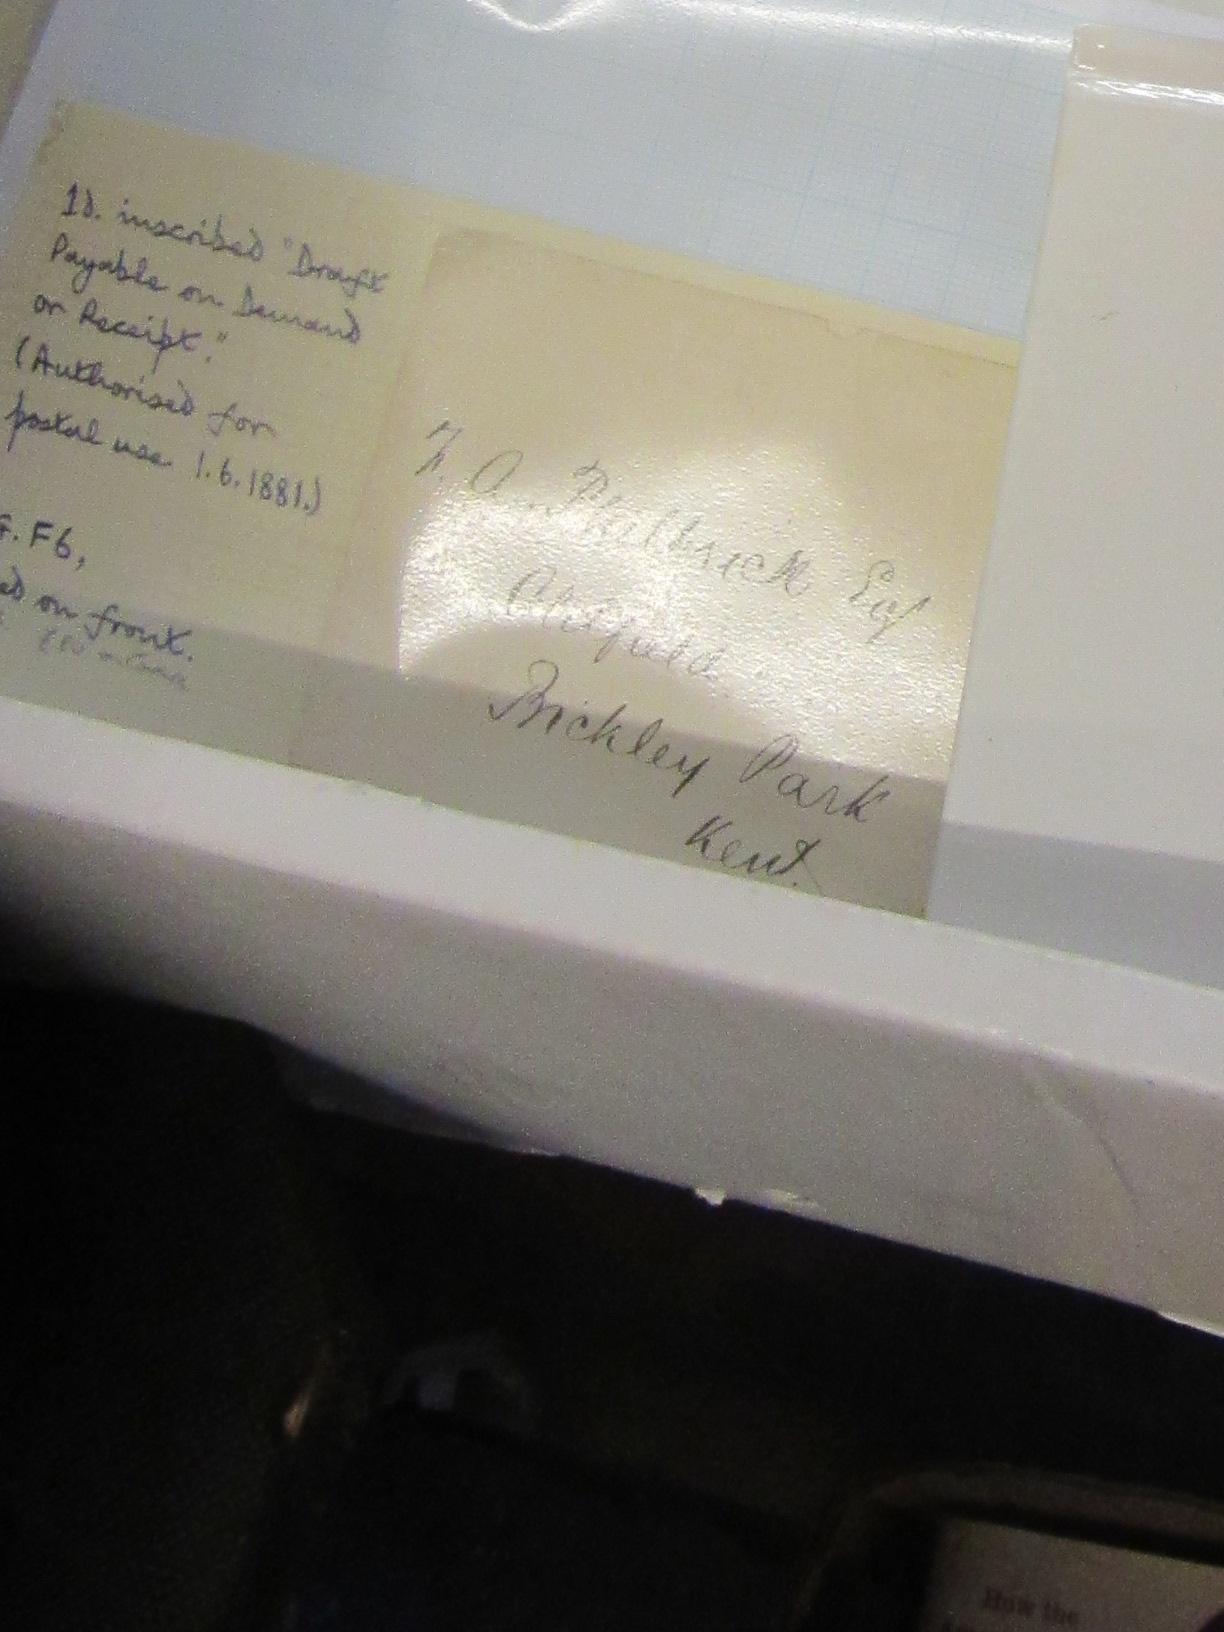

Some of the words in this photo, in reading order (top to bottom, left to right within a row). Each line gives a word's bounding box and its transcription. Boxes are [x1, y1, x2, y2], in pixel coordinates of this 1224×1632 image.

[117, 198, 265, 262] inscribed
[50, 231, 170, 295] Payable
[177, 283, 225, 309] on
[232, 282, 362, 345] Demand
[5, 390, 102, 452] postal
[112, 435, 173, 467] use
[207, 402, 279, 438] for
[35, 593, 79, 620] on
[488, 659, 710, 799] Bickley
[738, 733, 890, 825] Park
